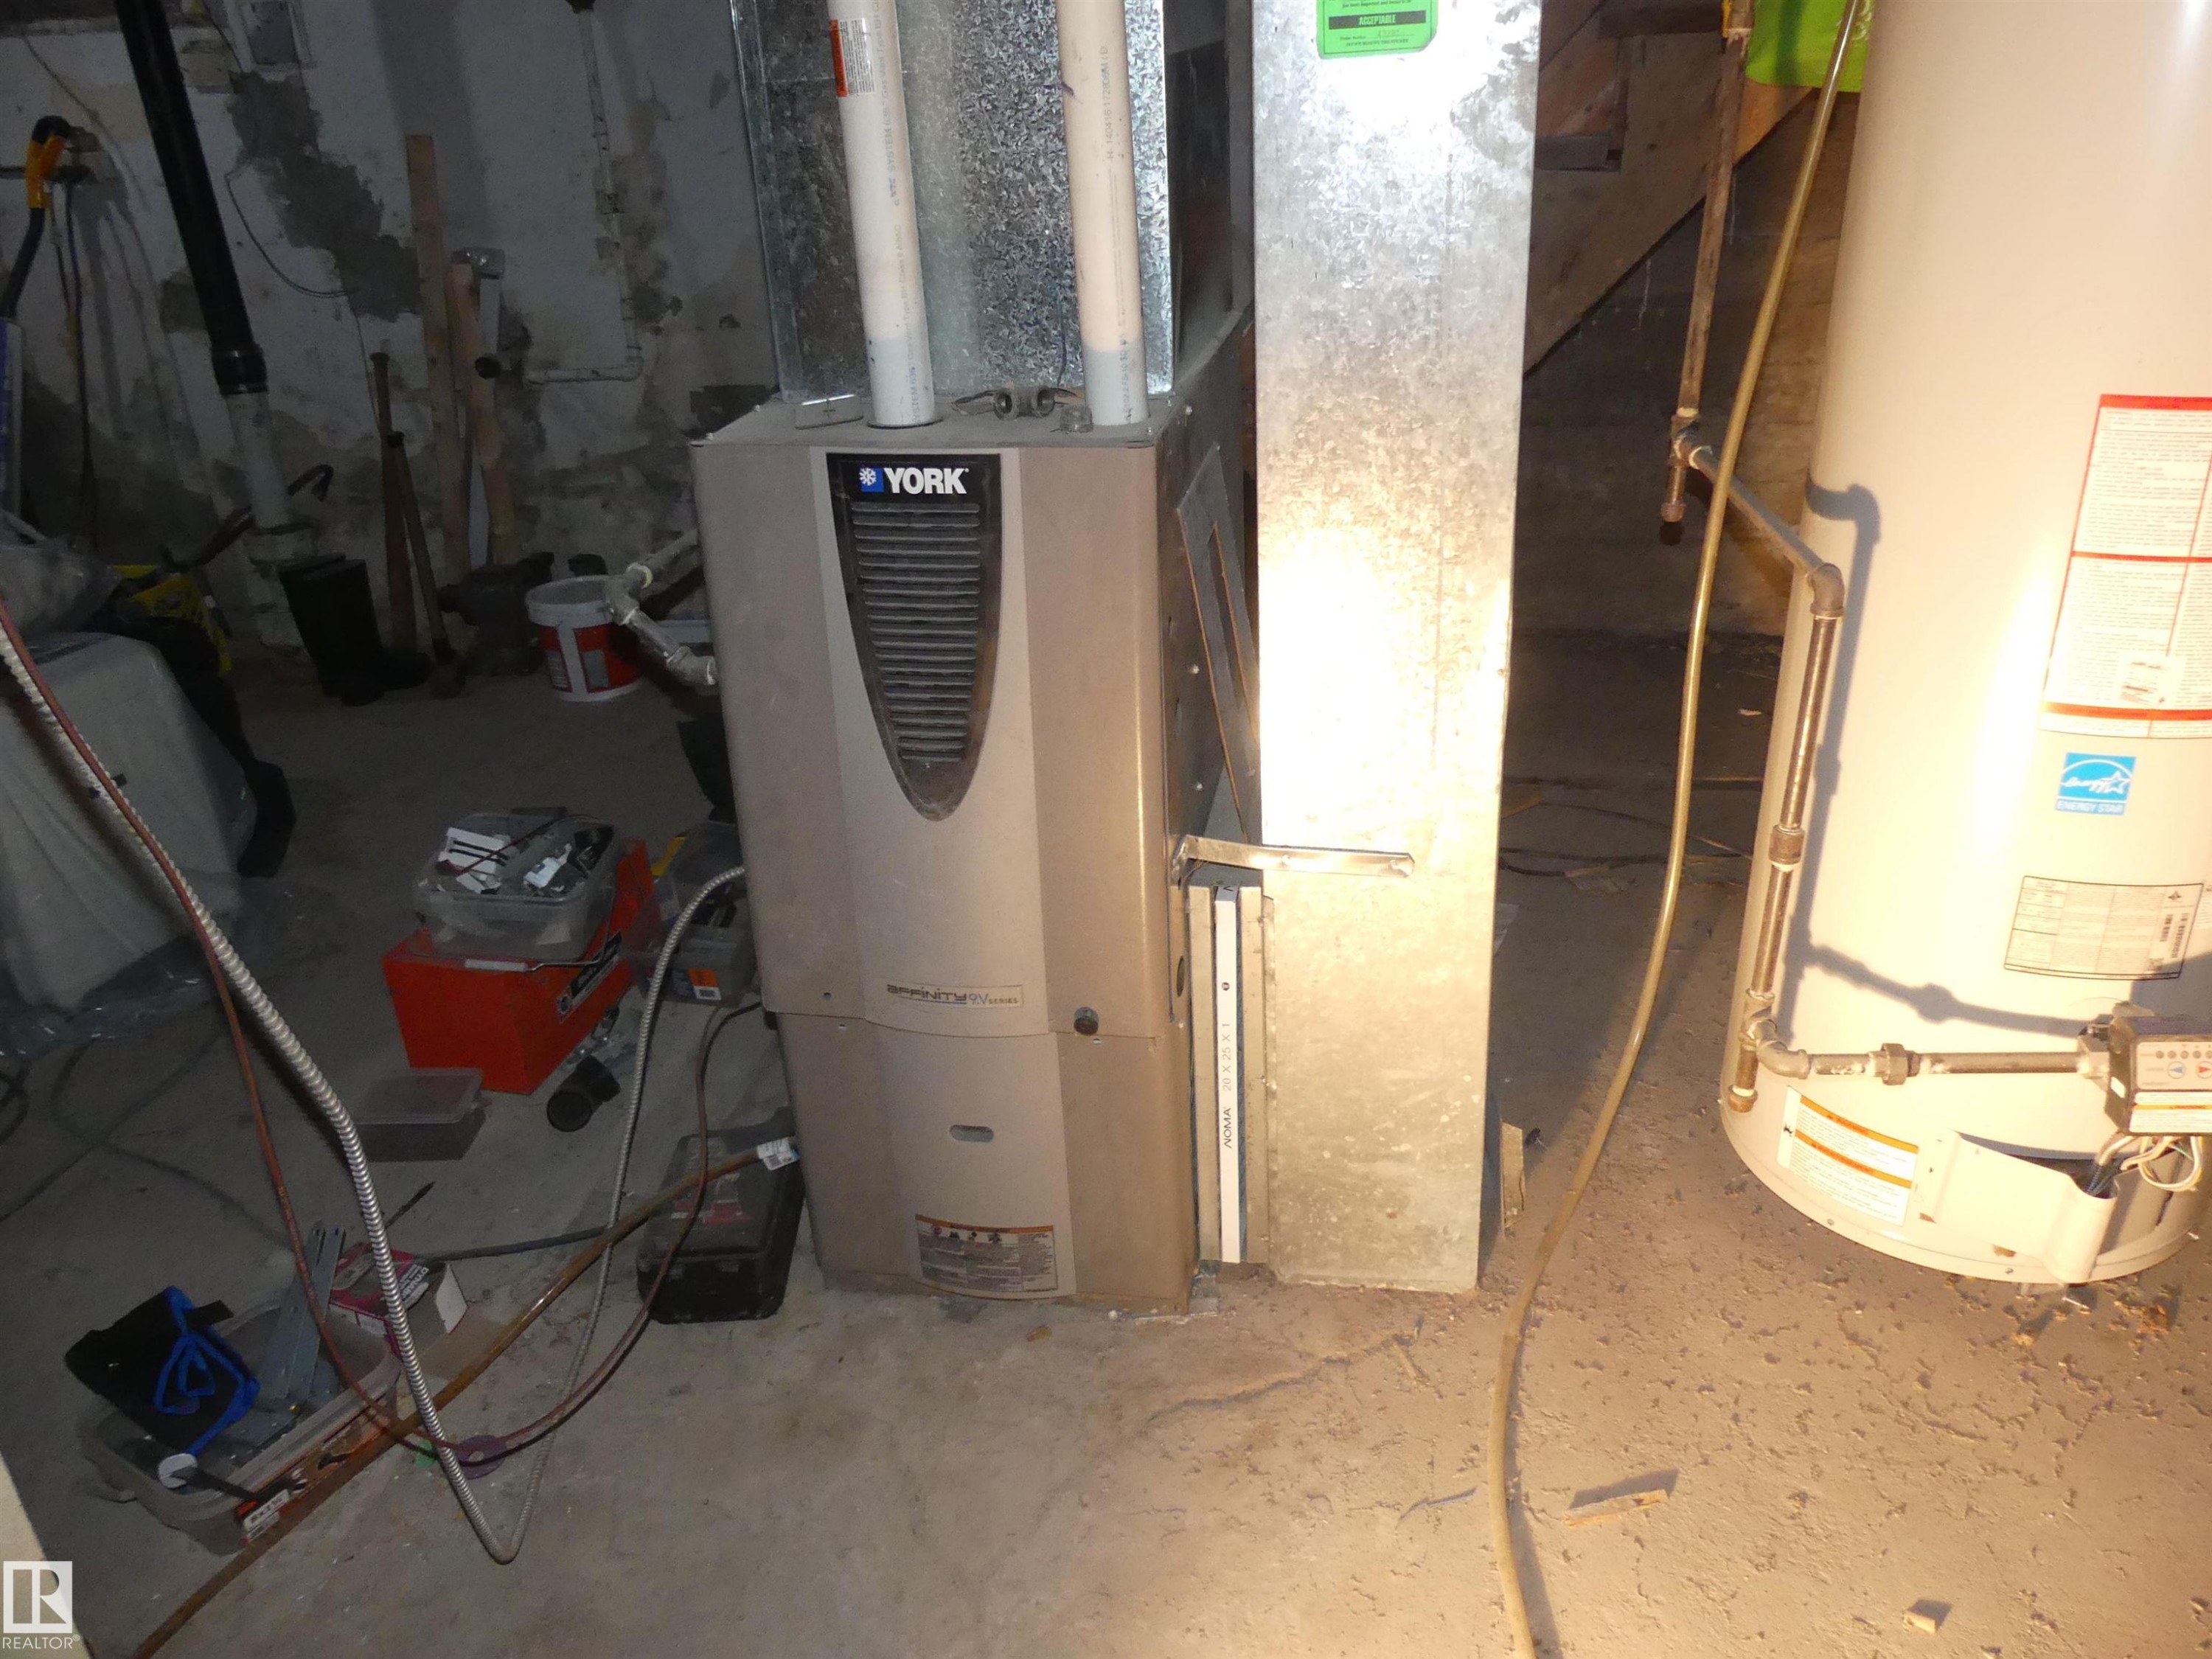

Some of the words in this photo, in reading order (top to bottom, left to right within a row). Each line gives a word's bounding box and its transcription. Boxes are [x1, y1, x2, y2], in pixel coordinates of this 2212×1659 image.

[1359, 14, 1397, 25] ACCEPTABLE
[884, 467, 967, 494] YORK
[2057, 801, 2096, 813] ENERGY
[2098, 804, 2124, 813] STAR
[1222, 1047, 1231, 1060] 25
[1222, 1078, 1231, 1091] 20
[1223, 1107, 1232, 1149] NOMA
